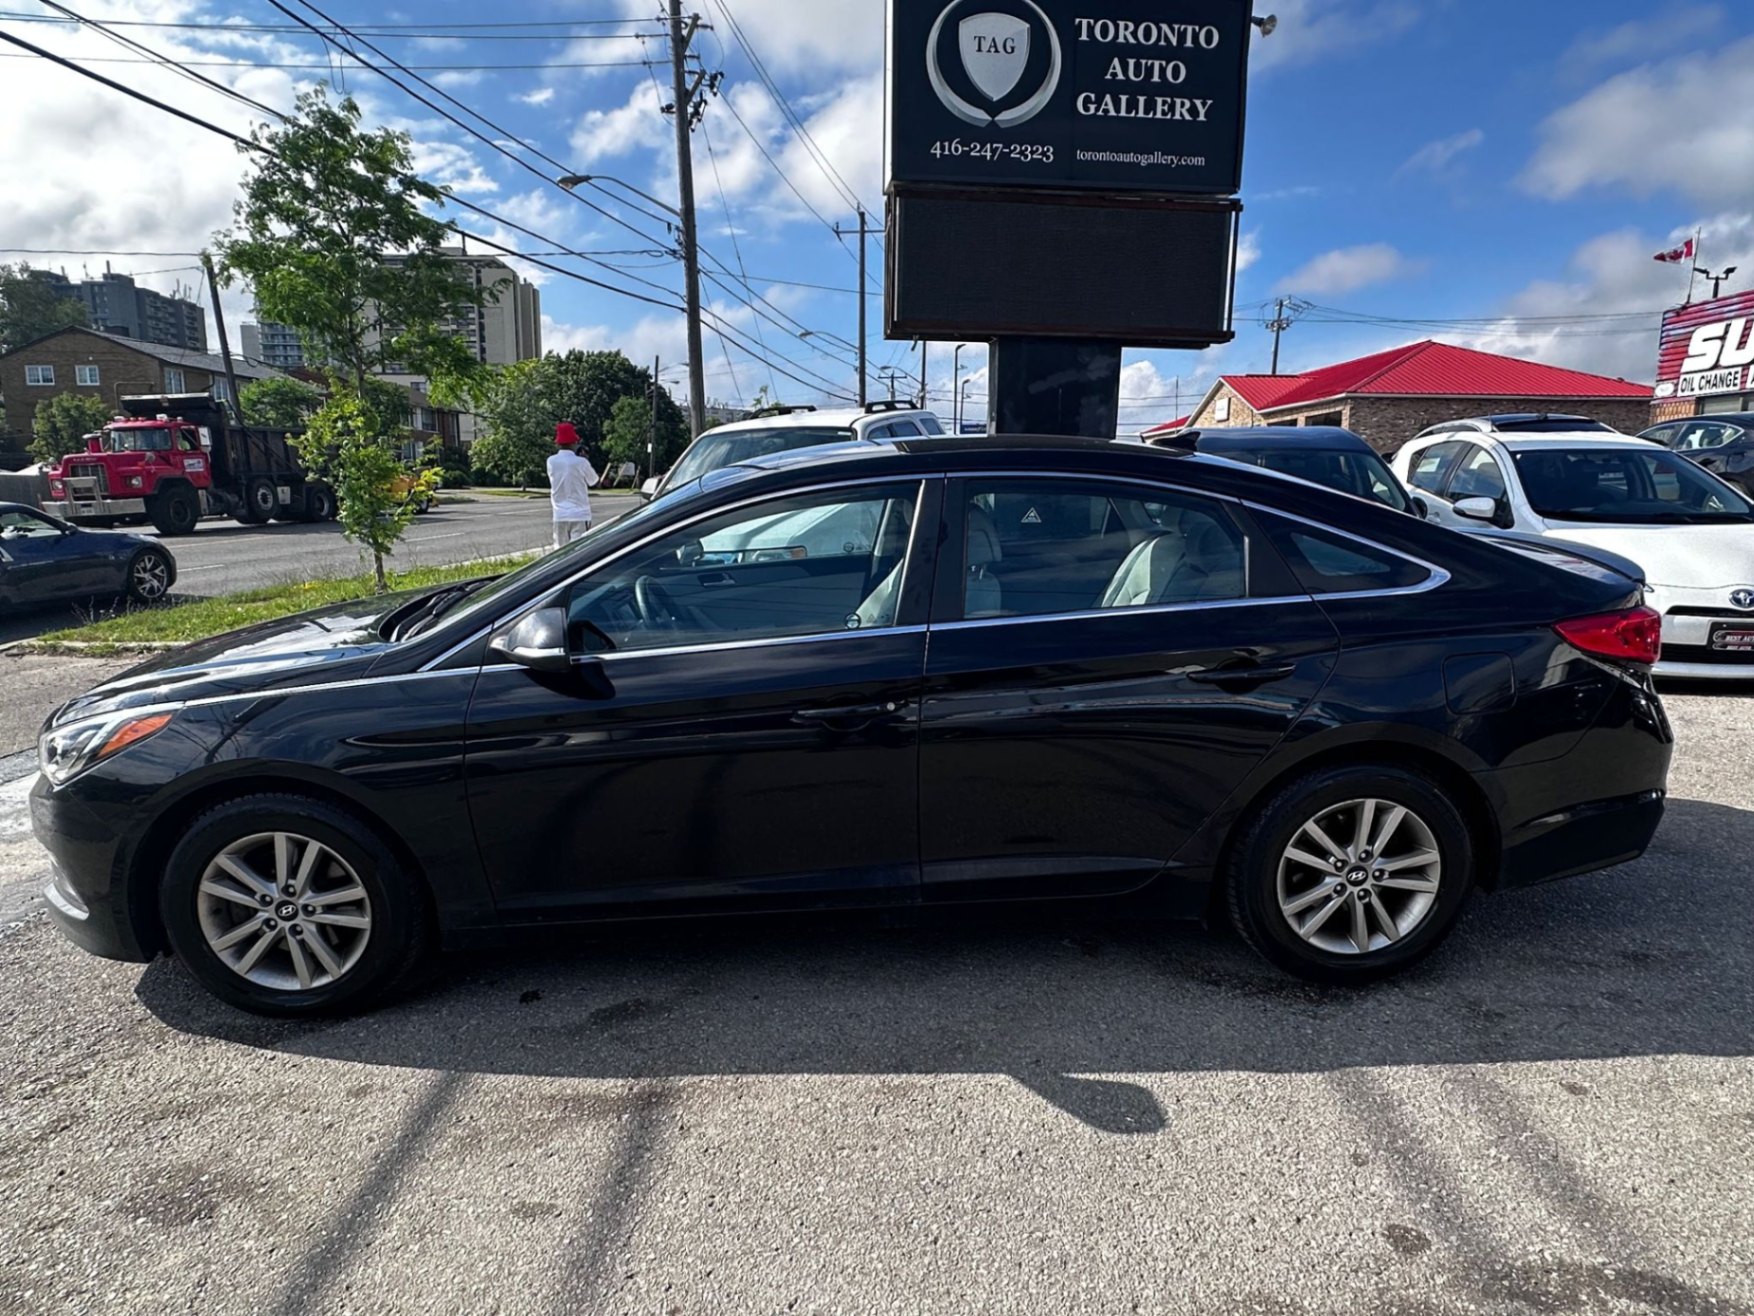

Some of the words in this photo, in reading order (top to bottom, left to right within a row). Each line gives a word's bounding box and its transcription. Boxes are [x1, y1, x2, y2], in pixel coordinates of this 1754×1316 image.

[973, 35, 1017, 55] TAG
[1074, 17, 1220, 49] TORONTO
[1104, 57, 1187, 84] AUTO
[1075, 92, 1214, 122] GALLERY
[929, 137, 1055, 164] 416-247-2323
[1075, 149, 1206, 167] torontoautogallery.com
[1680, 377, 1695, 393] OIL
[1698, 371, 1739, 390] CHANGE
